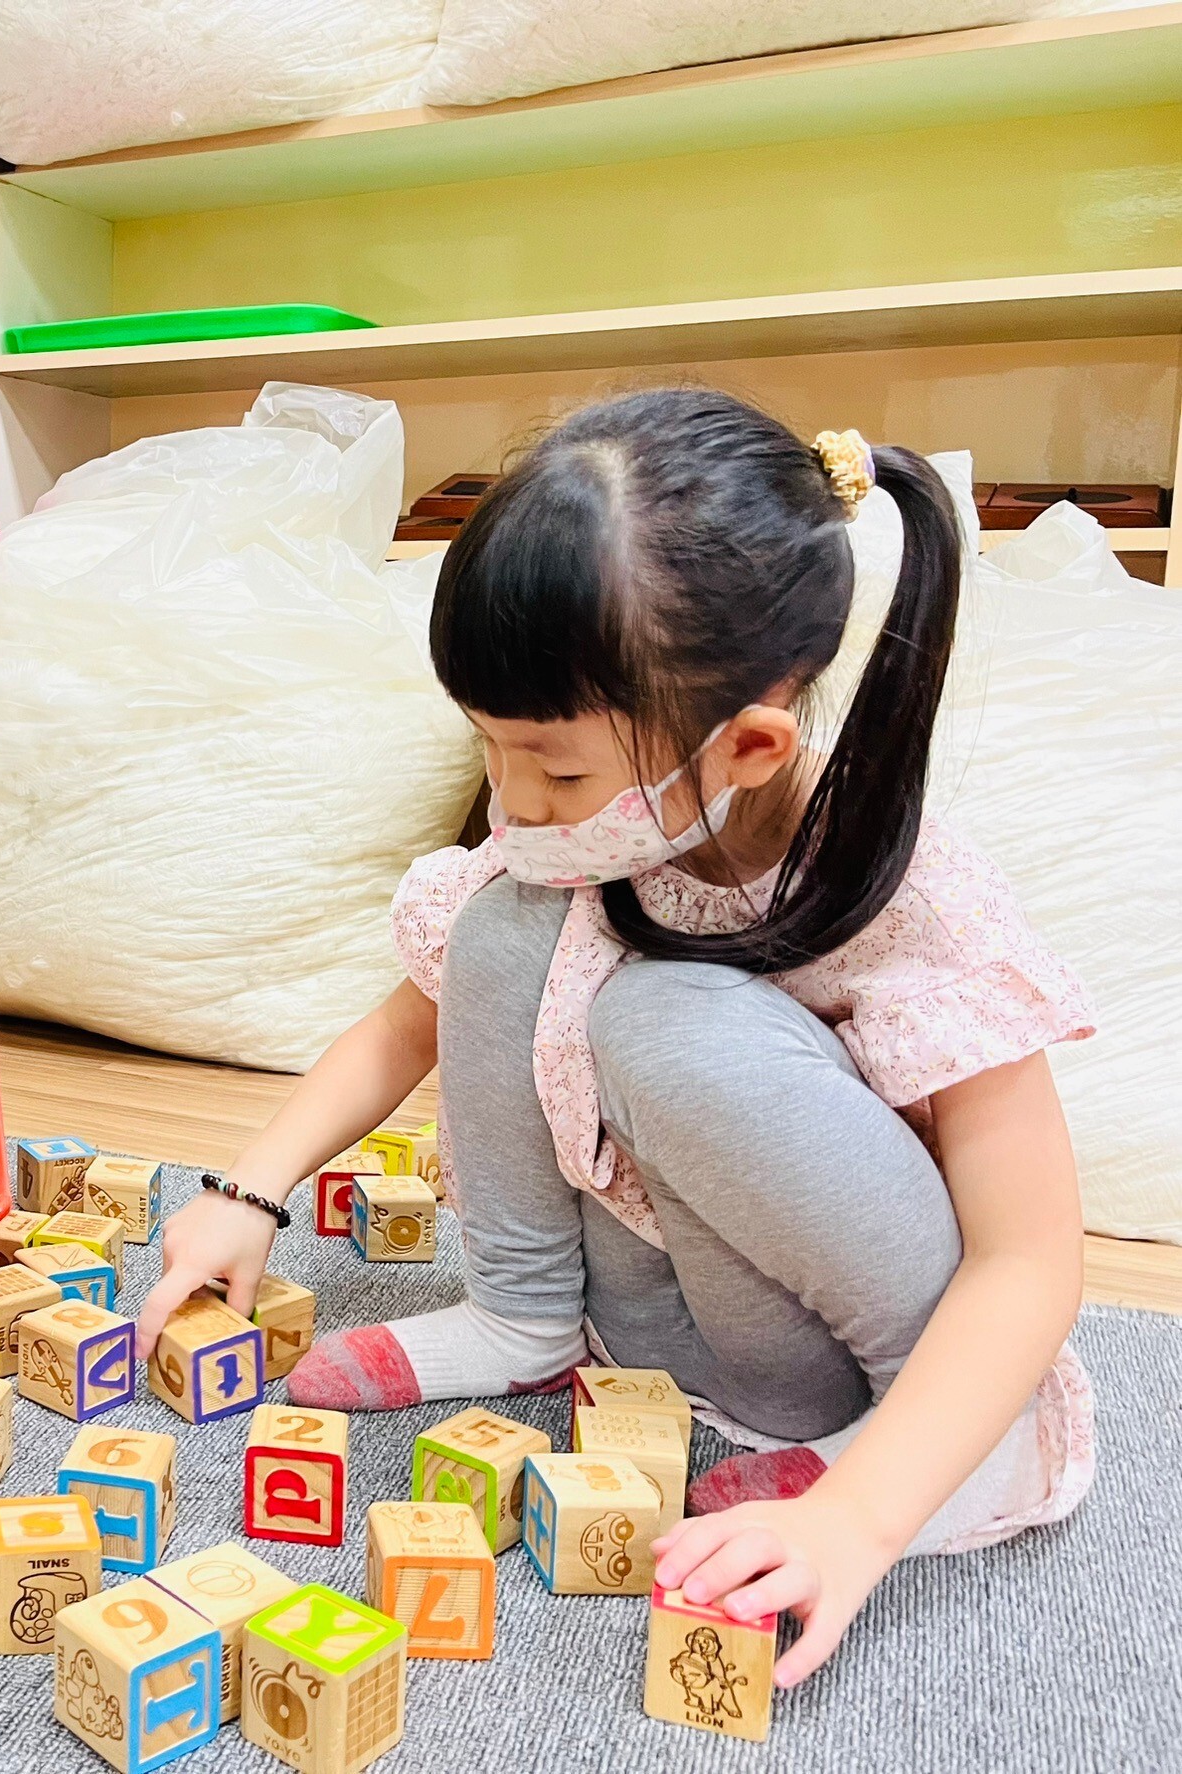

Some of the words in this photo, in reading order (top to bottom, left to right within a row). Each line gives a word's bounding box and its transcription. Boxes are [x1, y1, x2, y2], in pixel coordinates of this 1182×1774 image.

[54, 1157, 85, 1168] ROCKET
[52, 1307, 105, 1329] 8
[273, 1416, 324, 1443] 2
[450, 1420, 517, 1447] 5
[88, 1438, 146, 1467] 6
[19, 1511, 65, 1537] S
[28, 1558, 70, 1569] SNAIL
[288, 1597, 378, 1649] Y
[57, 1645, 66, 1700] TURTLE
[222, 1644, 234, 1702] ANCHOR
[685, 1711, 724, 1728] LION
[264, 1733, 301, 1762] YO-YO
